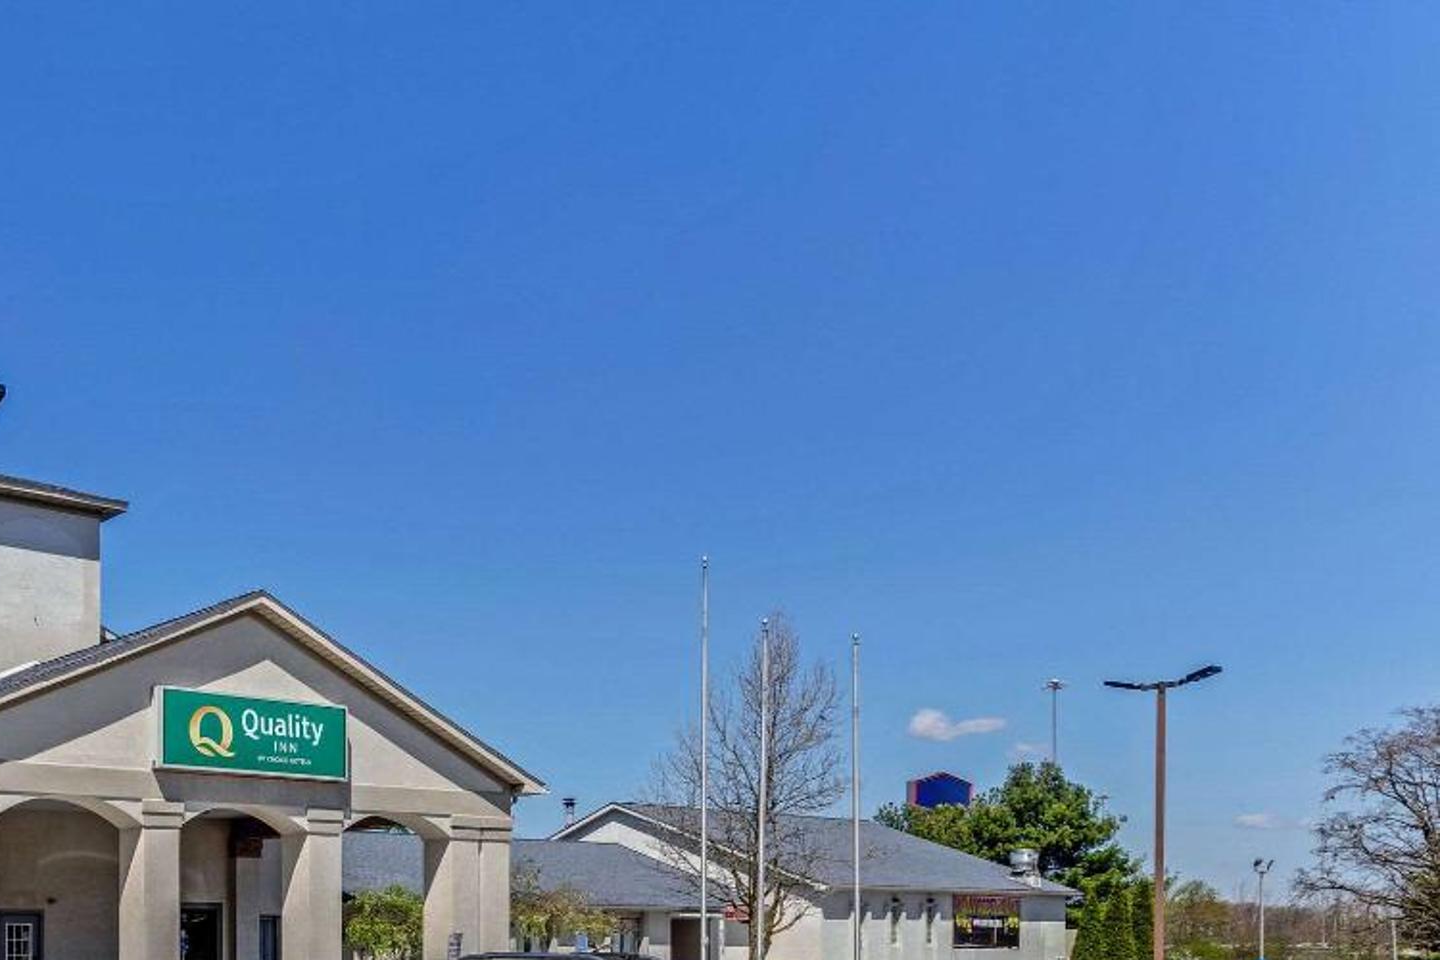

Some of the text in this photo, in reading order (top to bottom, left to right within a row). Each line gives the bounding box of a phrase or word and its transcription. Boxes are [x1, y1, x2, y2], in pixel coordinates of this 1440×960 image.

[188, 705, 236, 758] Q
[241, 708, 324, 747] Quality
[273, 740, 298, 754] INN
